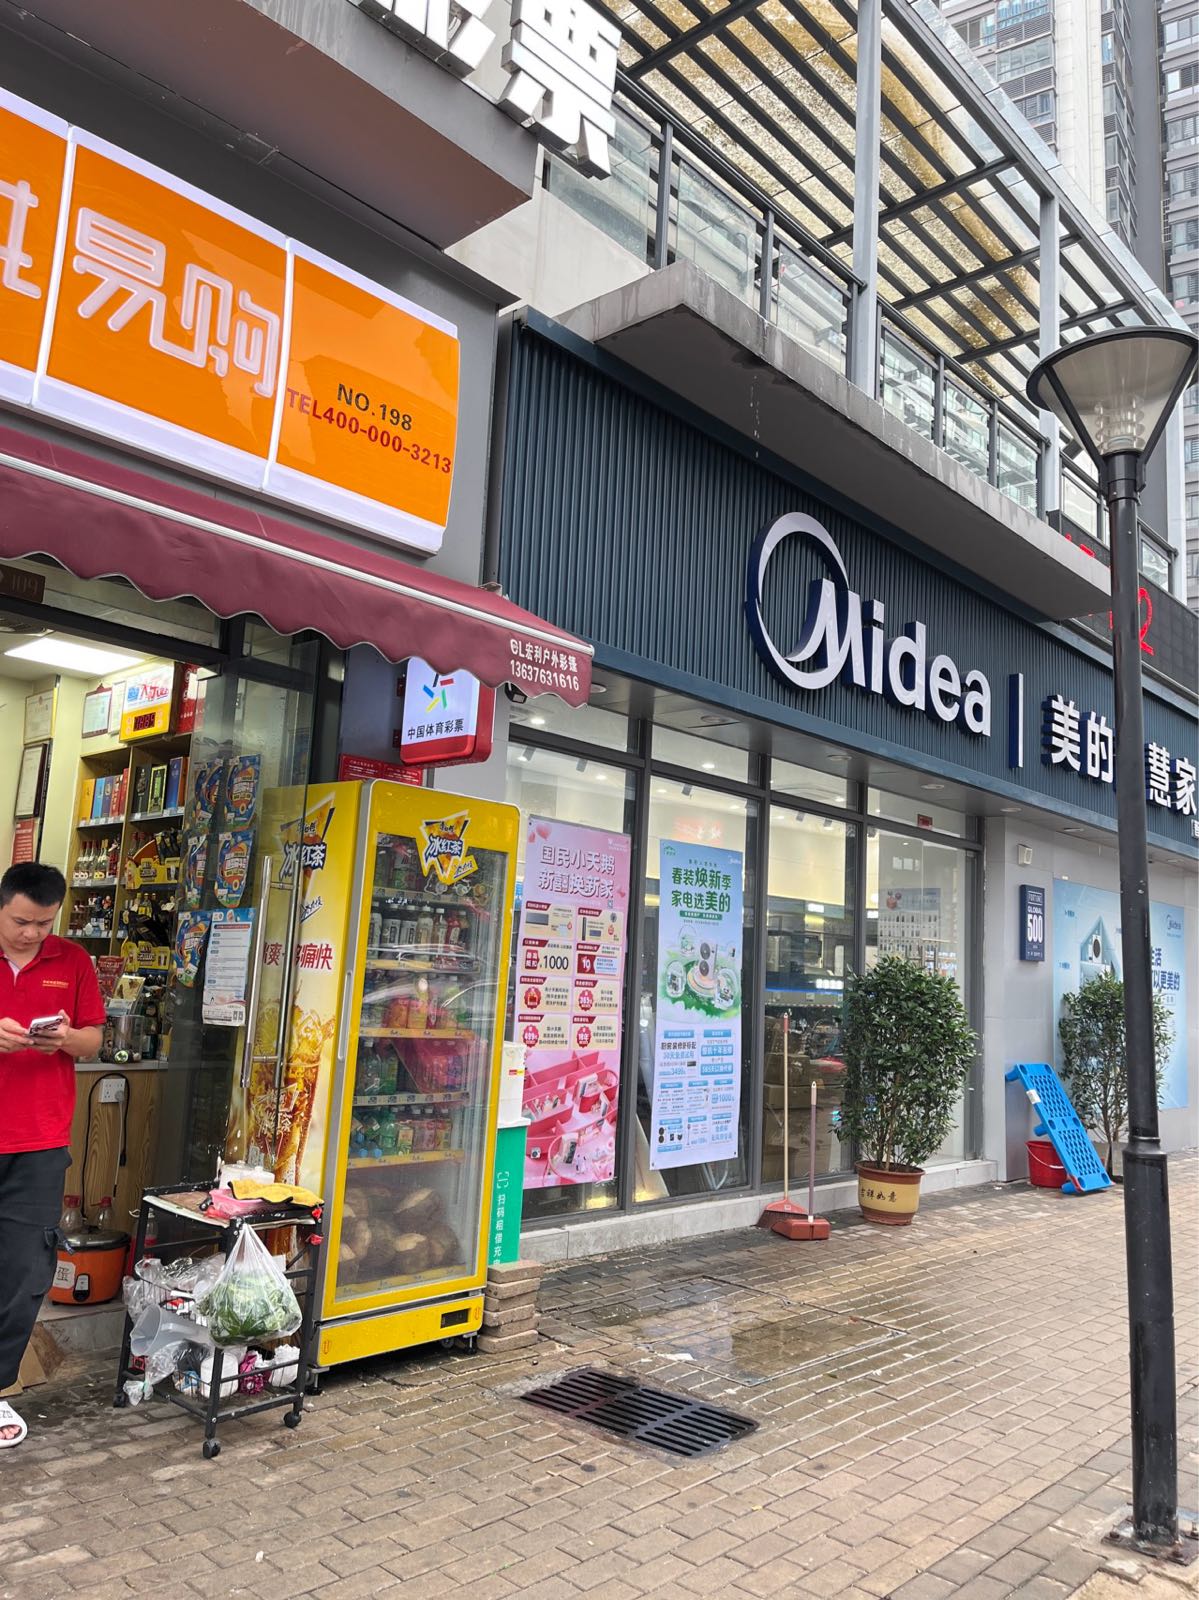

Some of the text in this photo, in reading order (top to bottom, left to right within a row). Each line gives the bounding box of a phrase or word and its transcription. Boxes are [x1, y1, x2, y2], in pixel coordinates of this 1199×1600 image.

[337, 383, 412, 431] NO.198
[286, 388, 452, 474] TEL400-000-3213
[756, 511, 991, 737] Midea
[510, 659, 579, 691] 13637631616
[407, 717, 464, 741] 中国体育彩票
[671, 867, 732, 890] 春装焕新季
[671, 890, 731, 912] 家电选美的
[1027, 913, 1043, 943] 500
[543, 955, 569, 970] 1000
[1152, 970, 1180, 991] 以更美的
[861, 1188, 897, 1203] 吉祥如意
